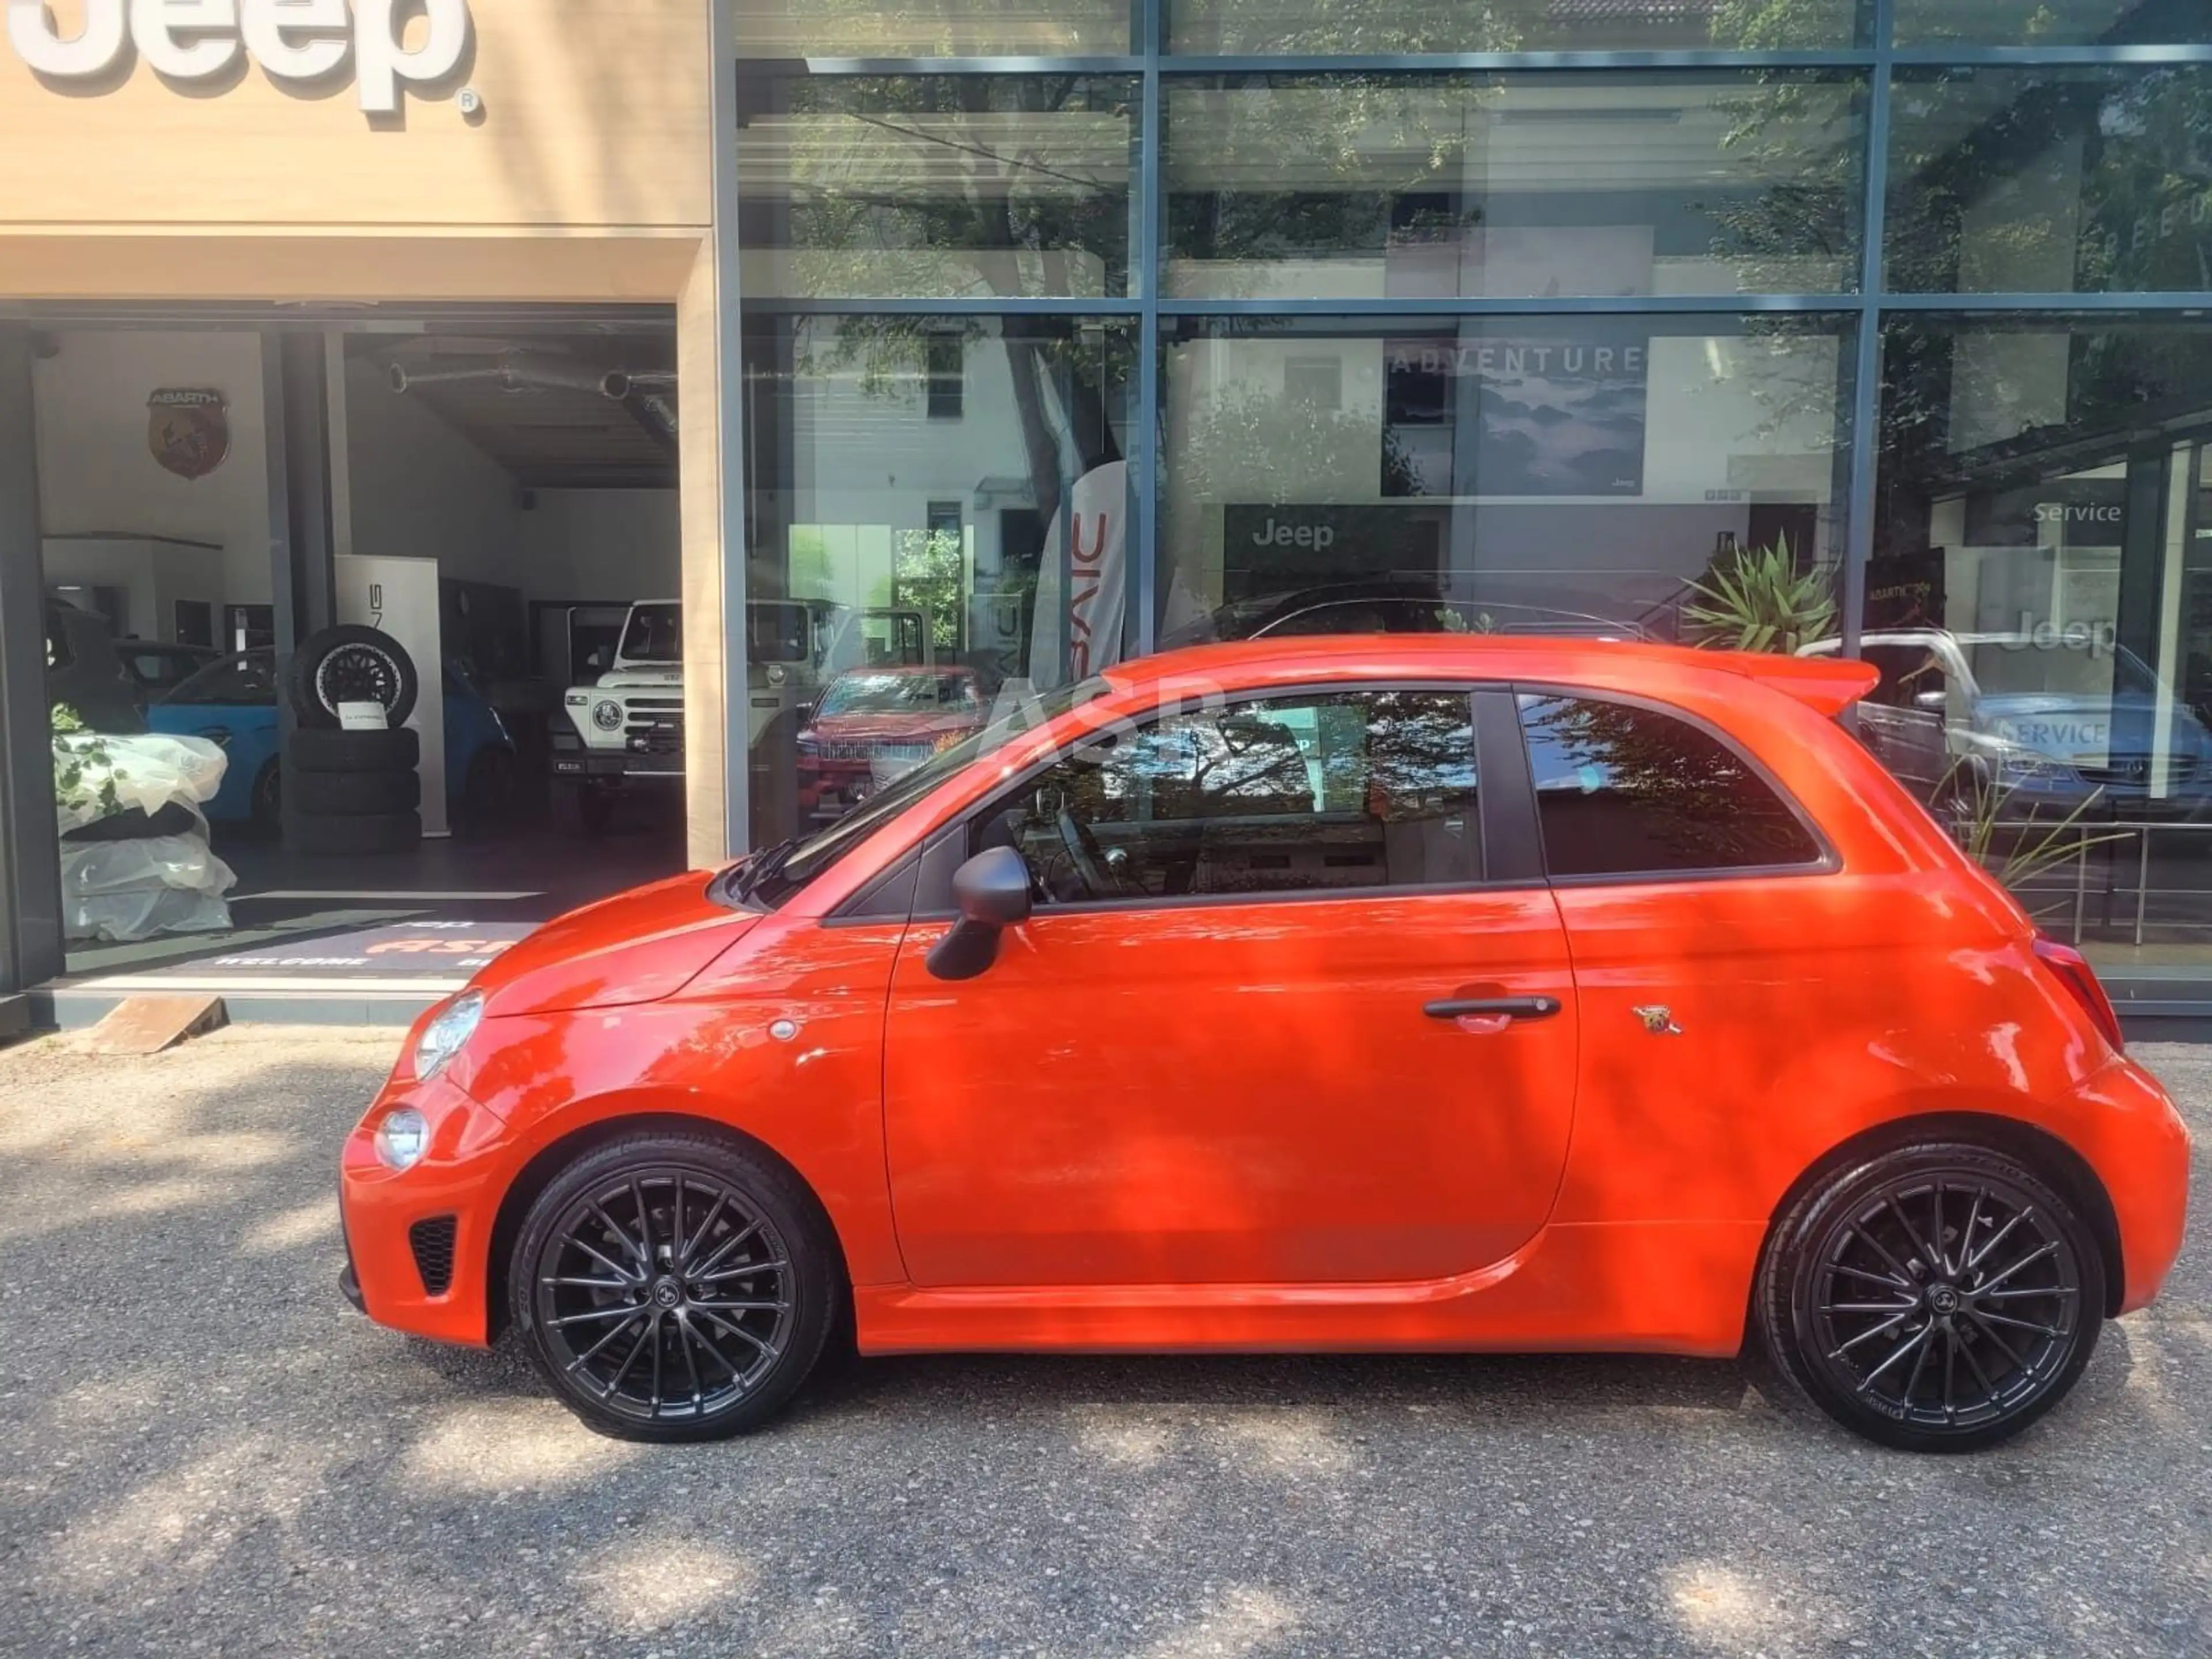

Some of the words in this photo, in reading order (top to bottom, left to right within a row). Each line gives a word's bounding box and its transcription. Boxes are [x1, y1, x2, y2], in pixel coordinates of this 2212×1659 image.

[7, 0, 465, 111] Jeep
[1391, 347, 1643, 373] ADVENTURE
[153, 392, 218, 403] ABARTH
[2033, 502, 2122, 521] Service
[1252, 518, 1334, 552] Jeep
[2001, 611, 2116, 658] Jeep
